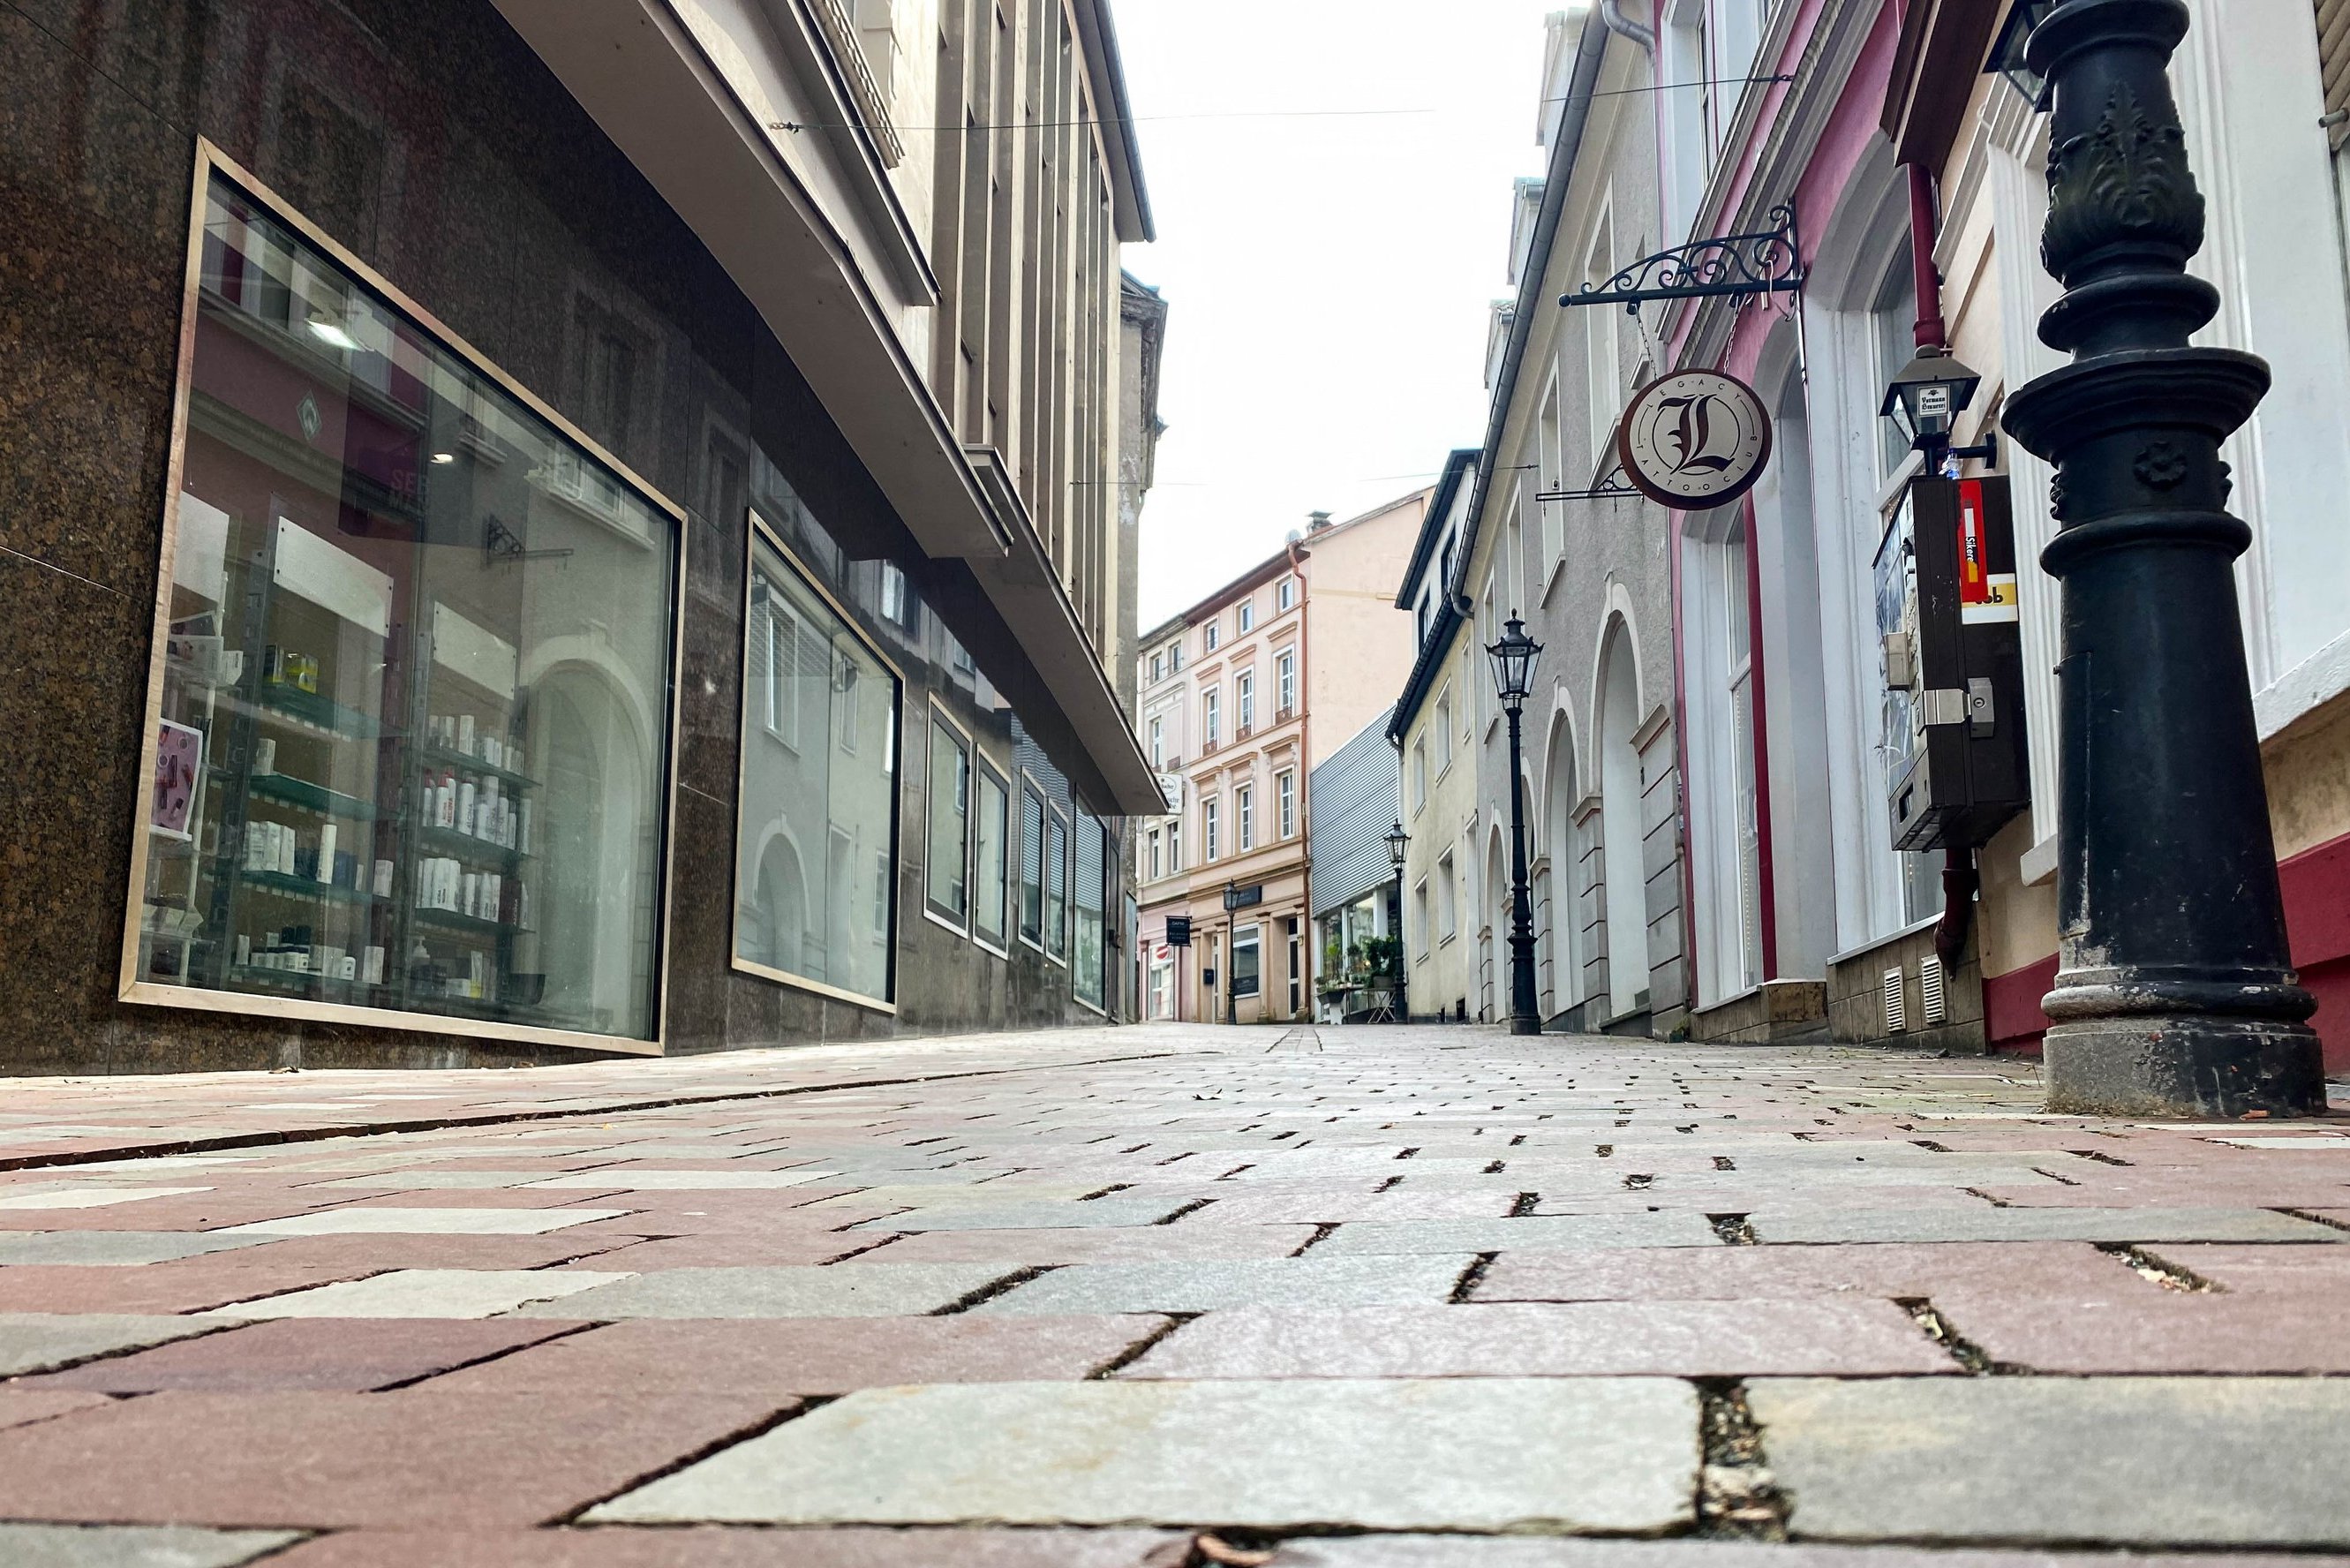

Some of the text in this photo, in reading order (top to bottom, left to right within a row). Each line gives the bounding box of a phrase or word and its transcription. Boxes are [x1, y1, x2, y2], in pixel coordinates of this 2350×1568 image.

[1646, 378, 1742, 408] LEGACY
[1657, 393, 1736, 475] L
[1636, 435, 1758, 492] TATTOO CLUB
